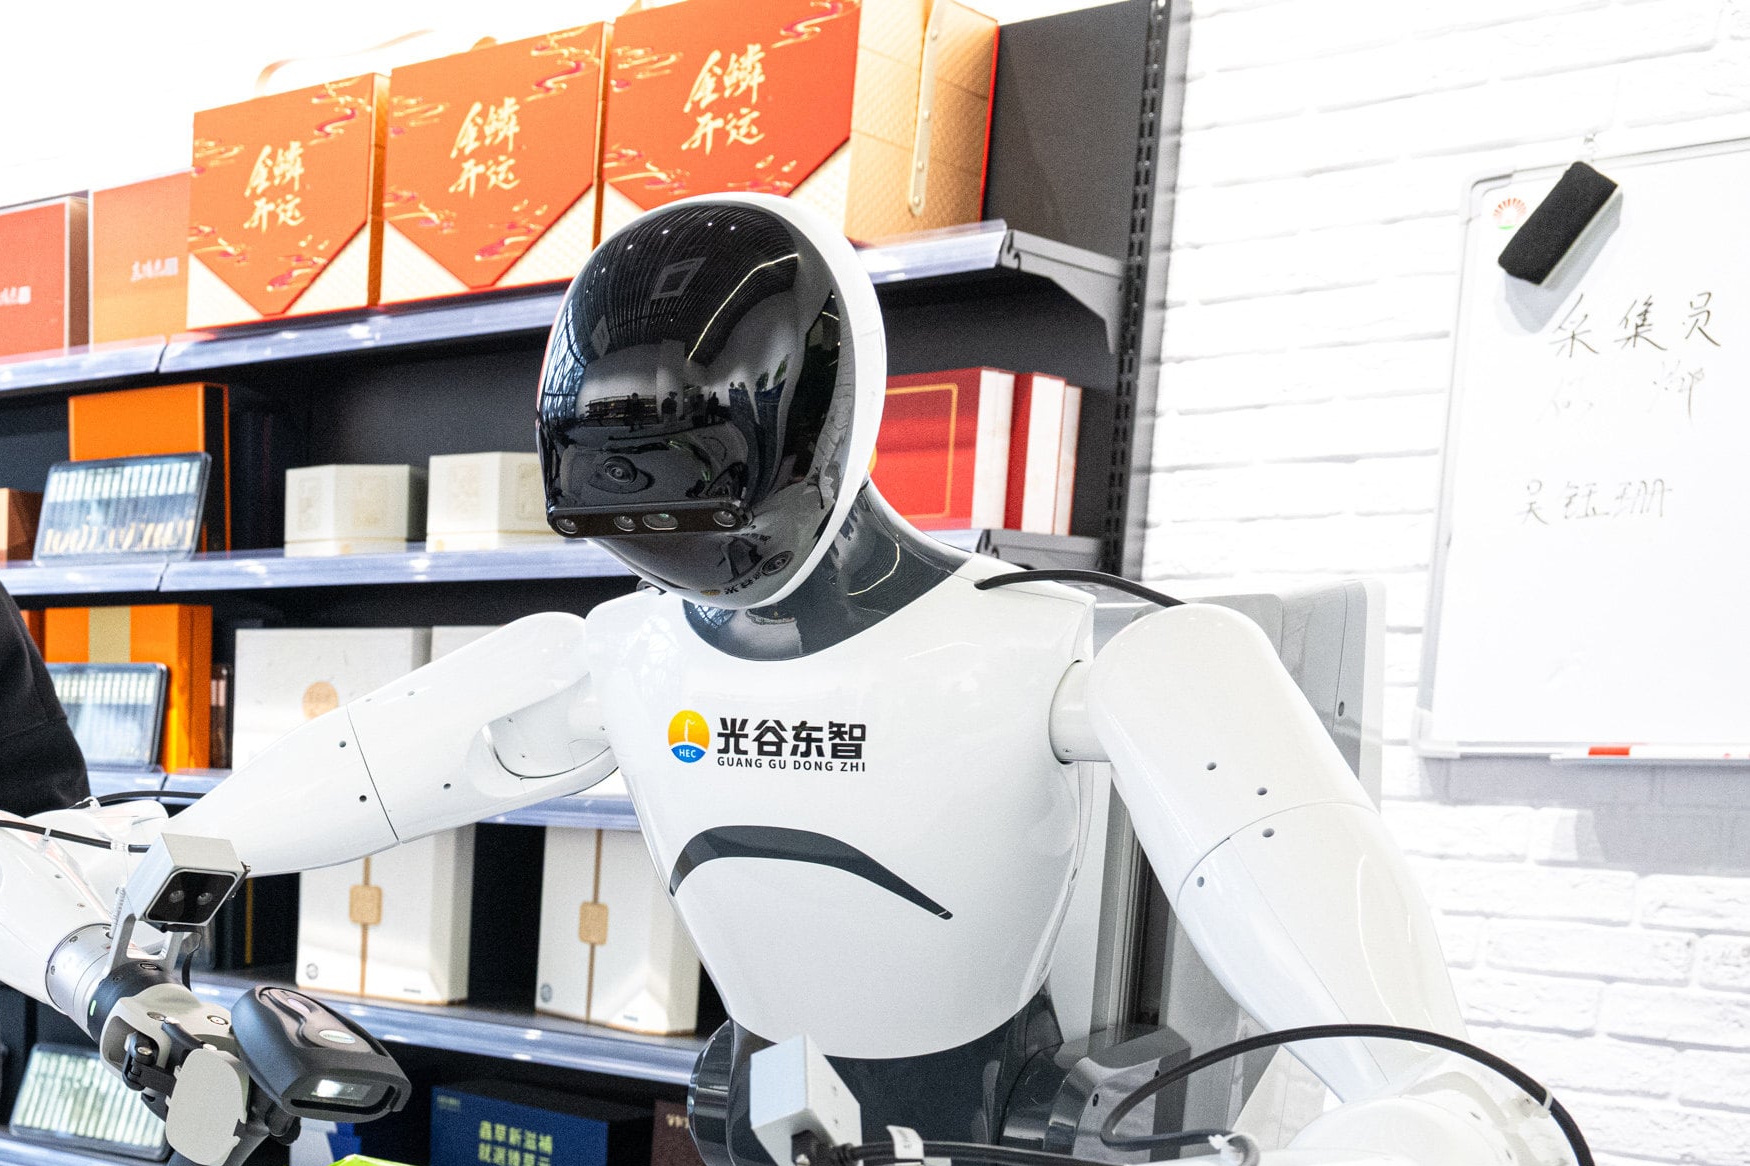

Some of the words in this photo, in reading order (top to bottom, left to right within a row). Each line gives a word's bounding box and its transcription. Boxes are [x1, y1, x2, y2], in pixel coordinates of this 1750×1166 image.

[717, 717, 867, 760] 光谷东智
[678, 748, 697, 759] HEC
[717, 756, 763, 769] GUANG
[768, 757, 787, 770] GU
[793, 759, 834, 772] DONG
[840, 761, 866, 772] ZHI
